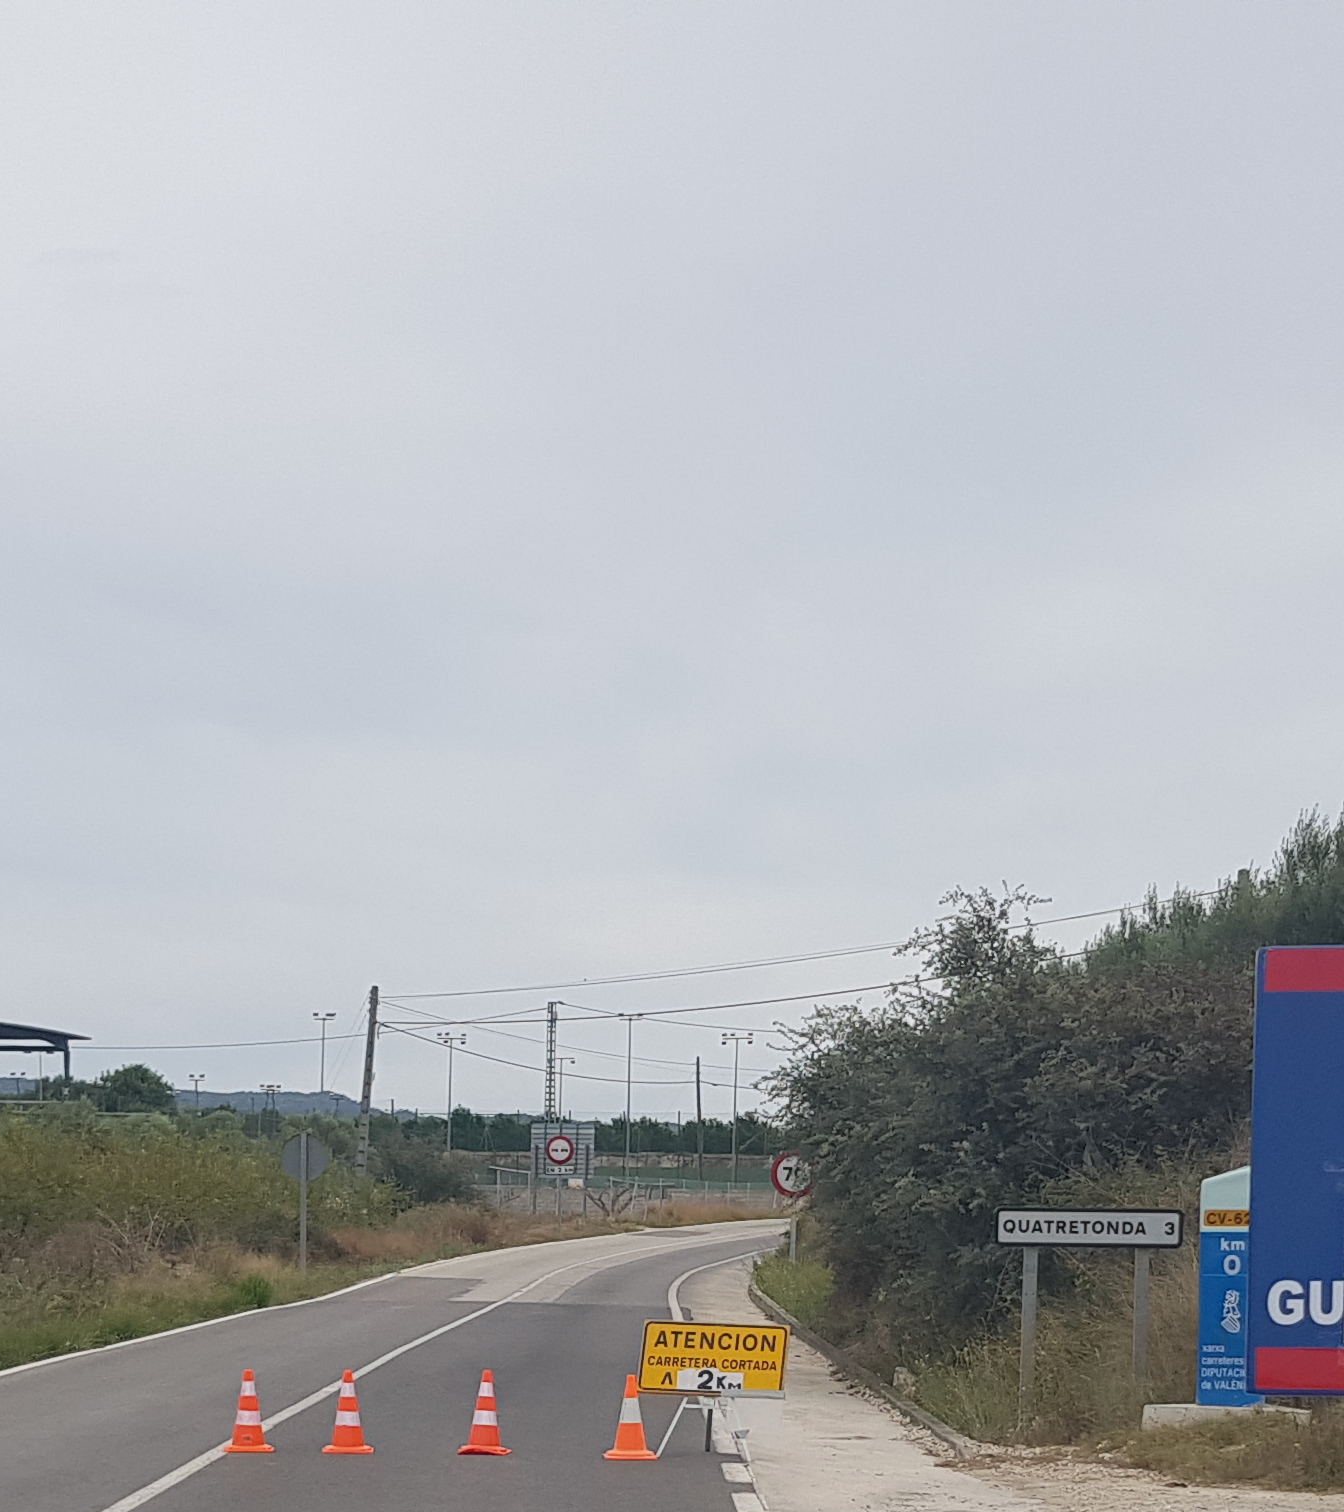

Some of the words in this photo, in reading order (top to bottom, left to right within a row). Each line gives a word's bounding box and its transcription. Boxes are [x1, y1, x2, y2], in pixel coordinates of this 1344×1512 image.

[1001, 1218, 1147, 1236] QUATRETONDA
[1163, 1222, 1175, 1236] 3
[1220, 1237, 1246, 1251] km
[1223, 1254, 1241, 1276] 0
[654, 1330, 777, 1352] ATENCION
[647, 1355, 717, 1368] CARRETERA
[721, 1358, 777, 1371] CORTADA
[697, 1369, 714, 1390] 2
[1213, 1379, 1244, 1390] VALÈN
